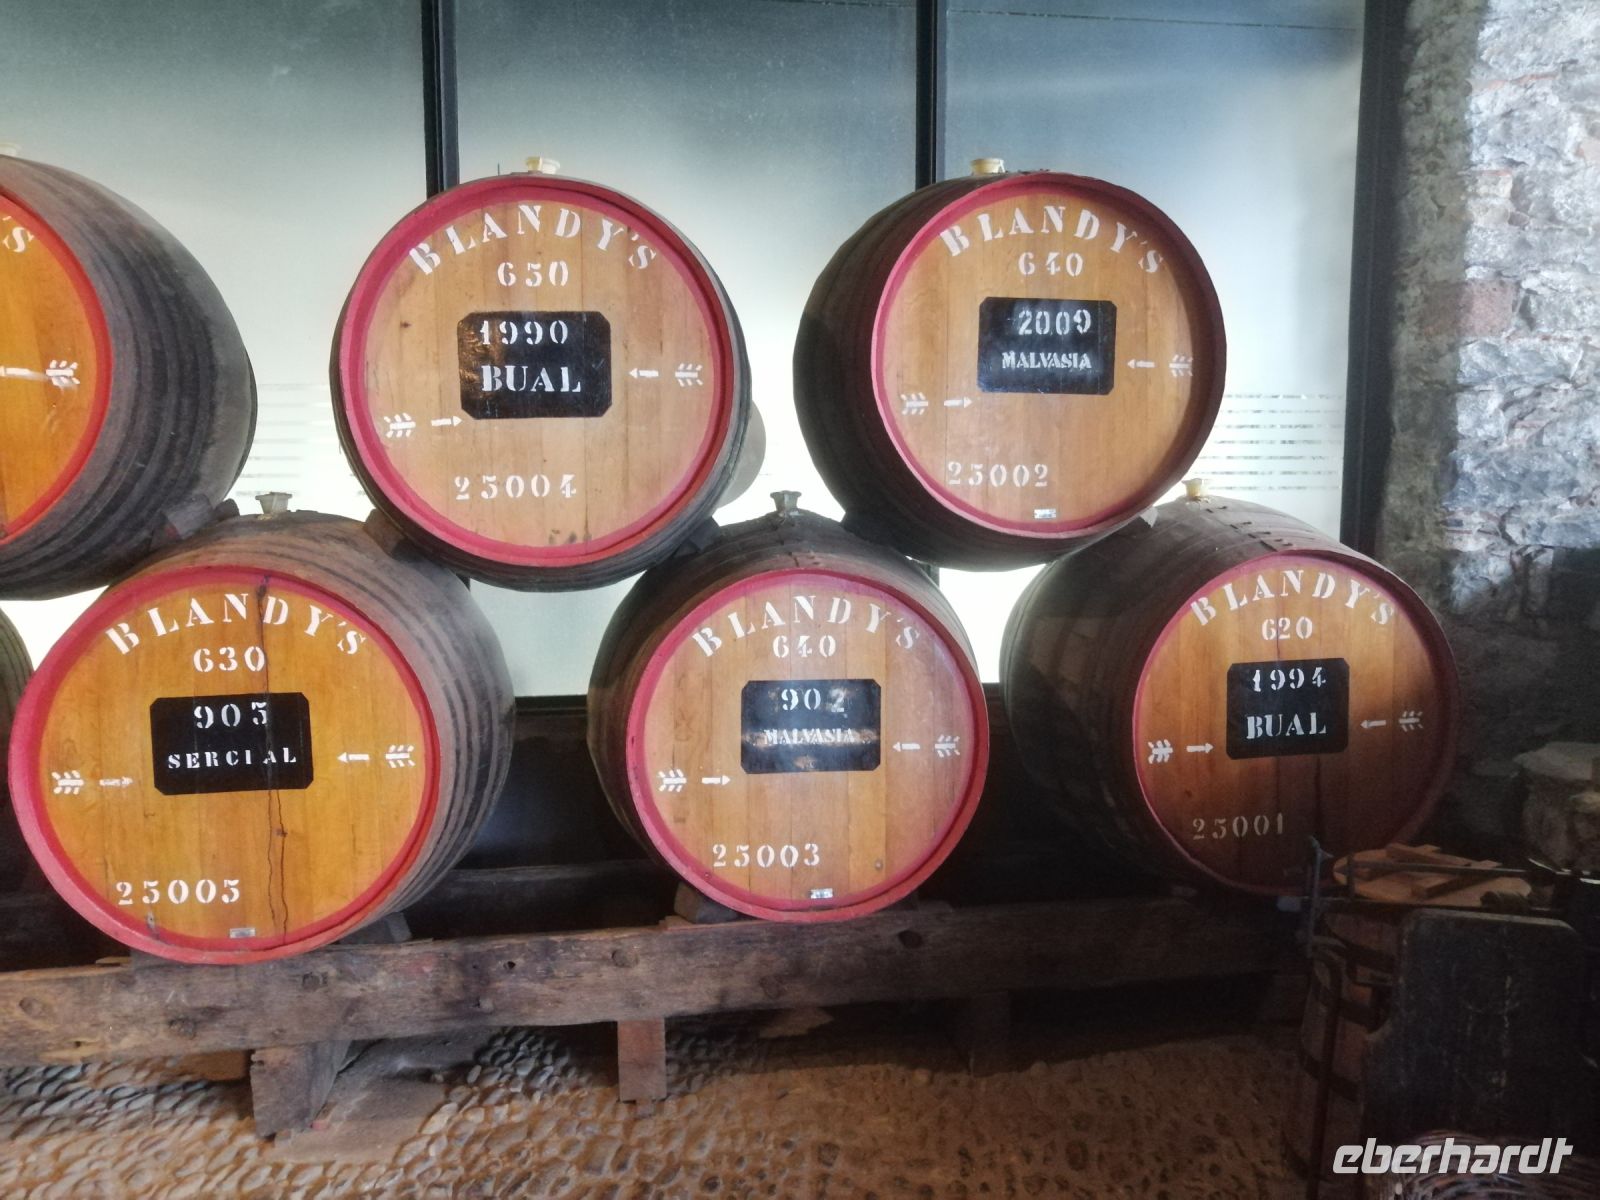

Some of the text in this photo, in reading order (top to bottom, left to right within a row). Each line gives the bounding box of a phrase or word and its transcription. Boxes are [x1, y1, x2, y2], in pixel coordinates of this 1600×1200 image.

[408, 204, 657, 276] BLANDY'S
[938, 205, 1165, 274] BLANDY'S
[497, 260, 570, 288] 650
[1018, 251, 1085, 278] 640
[480, 319, 570, 346] 1990
[1018, 308, 1093, 336] 2009
[1001, 351, 1093, 370] MALVASIA
[480, 364, 582, 394] BUAL
[453, 474, 578, 501] 25004
[947, 460, 1049, 488] 25002
[1190, 569, 1395, 627] BLANDY'S
[104, 592, 368, 656] BLANDY'S
[692, 594, 921, 658] BLANDY'S
[1261, 615, 1314, 641] 620
[193, 645, 266, 673] 630
[772, 634, 837, 659] 640
[1252, 666, 1327, 692] 1994
[781, 687, 846, 713] 902
[193, 701, 269, 729] 905
[1245, 711, 1328, 740] BUAL
[763, 727, 857, 745] MALVASIA
[1192, 812, 1284, 841] 25001
[712, 842, 821, 868] 25003
[115, 878, 241, 906] 25005
